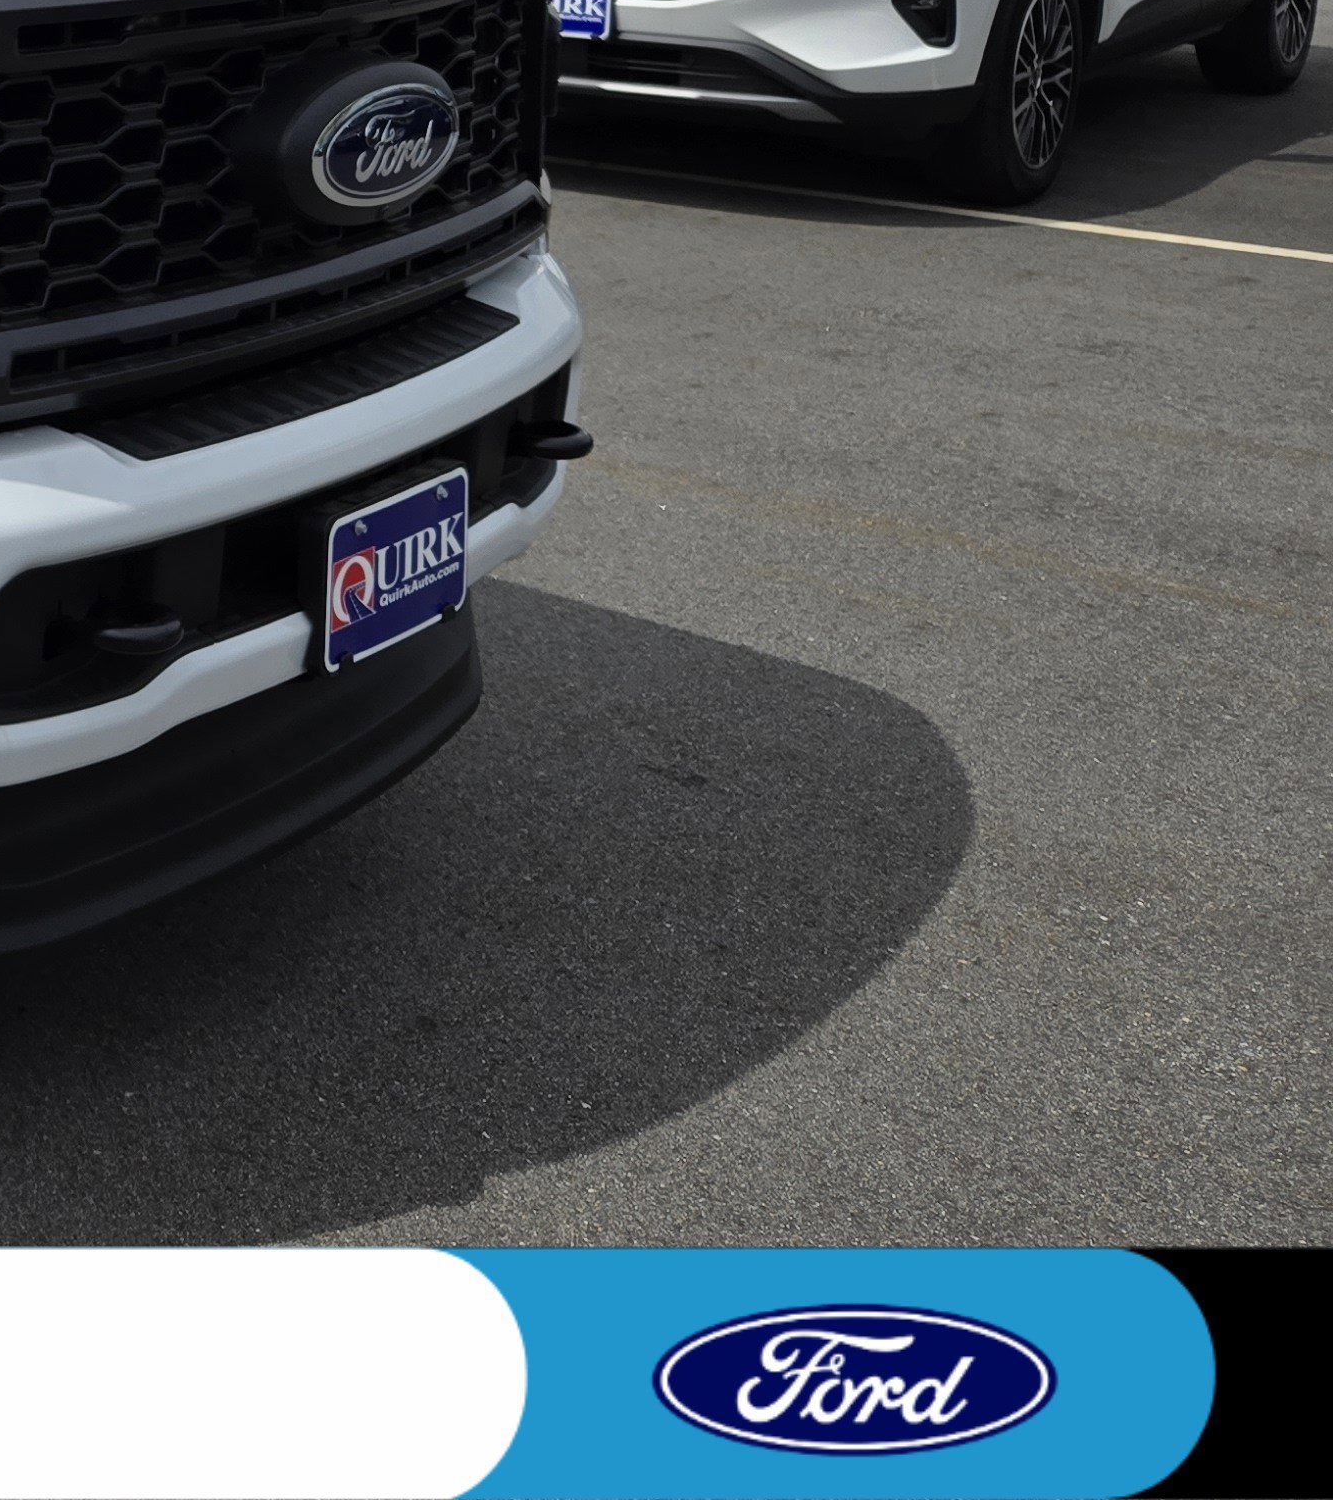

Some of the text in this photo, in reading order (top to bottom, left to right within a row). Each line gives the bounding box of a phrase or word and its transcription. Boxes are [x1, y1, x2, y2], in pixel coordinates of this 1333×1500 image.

[355, 109, 434, 183] Ford
[333, 511, 465, 625] QUIRK
[379, 561, 460, 607] QuirkAuto.com
